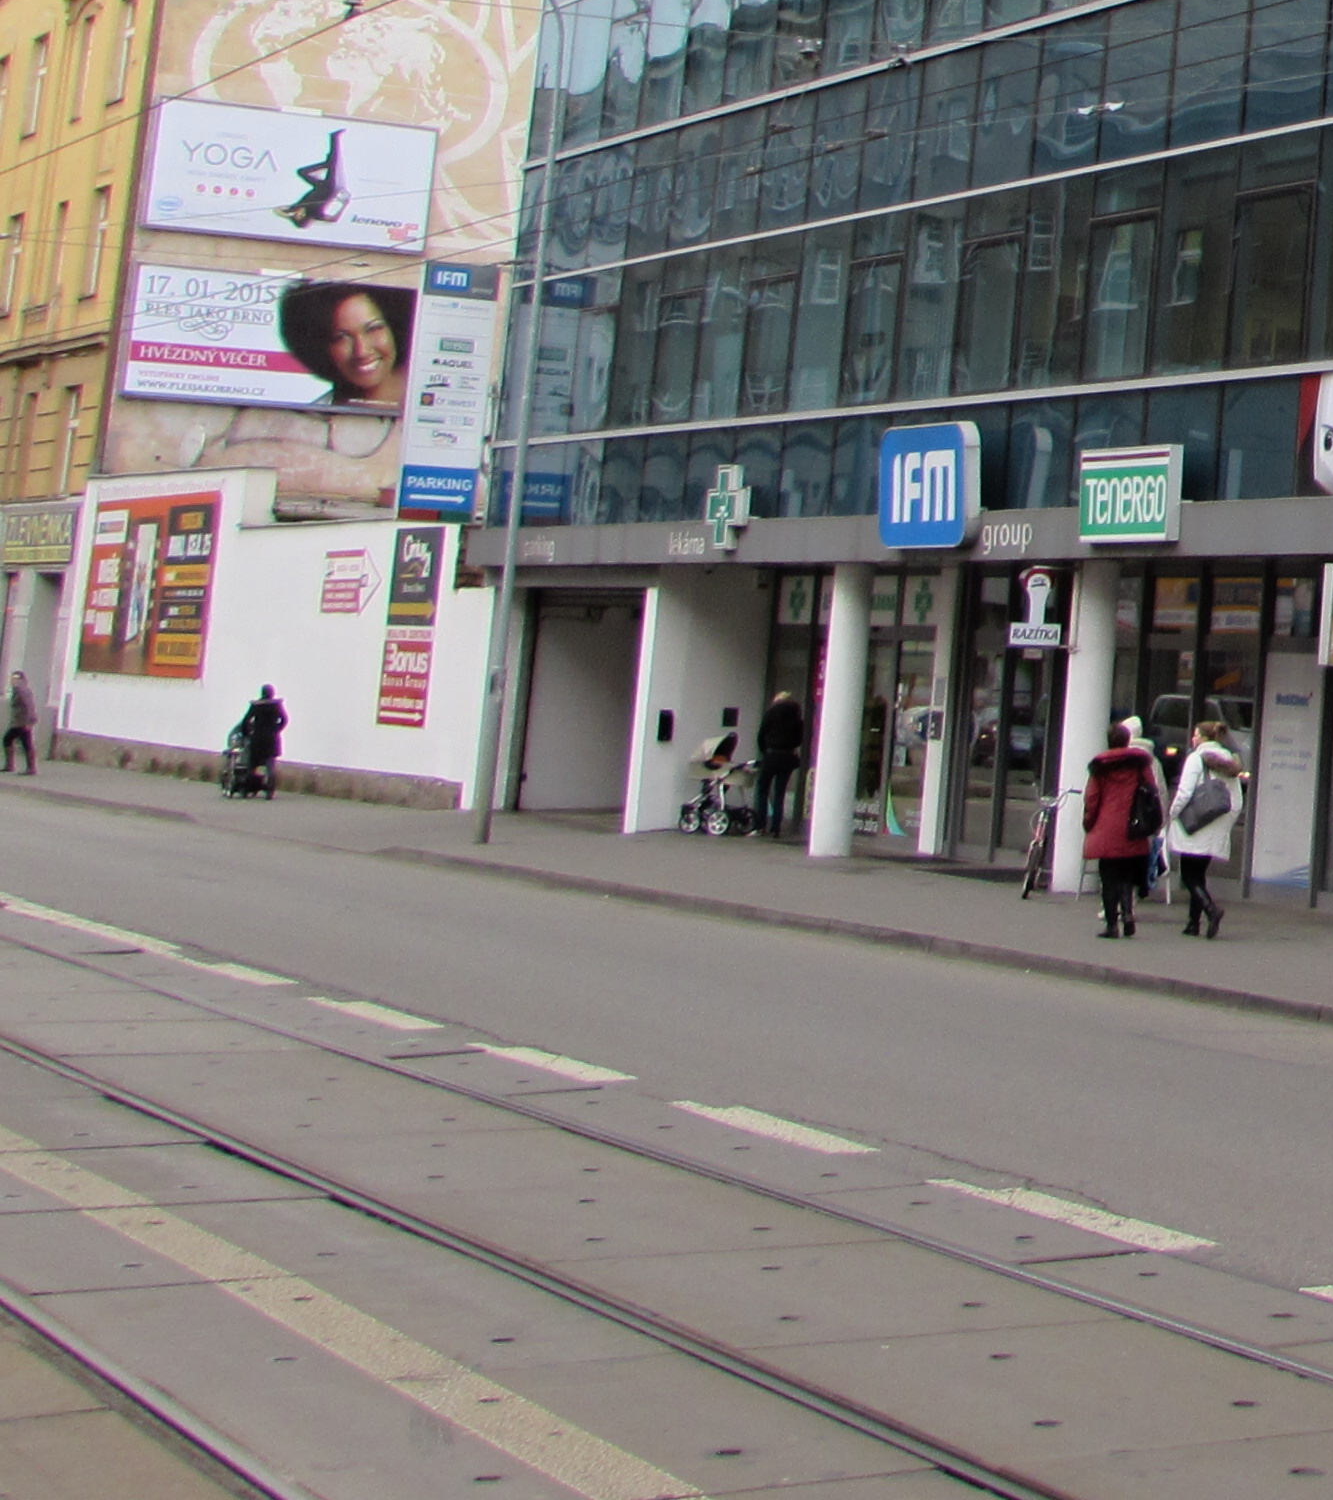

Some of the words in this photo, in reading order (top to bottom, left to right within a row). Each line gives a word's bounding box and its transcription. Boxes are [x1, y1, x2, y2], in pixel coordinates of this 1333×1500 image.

[182, 139, 278, 172] YOGA
[437, 270, 469, 287] IFM
[225, 281, 277, 305] 2015
[231, 309, 275, 325] BRNO
[138, 344, 216, 366] HVĚZDNÝ
[219, 348, 268, 368] VEČER
[406, 475, 473, 492] PARKING
[891, 448, 956, 524] IFM
[982, 520, 1033, 555] group
[1011, 627, 1060, 641] RAZÍTKA
